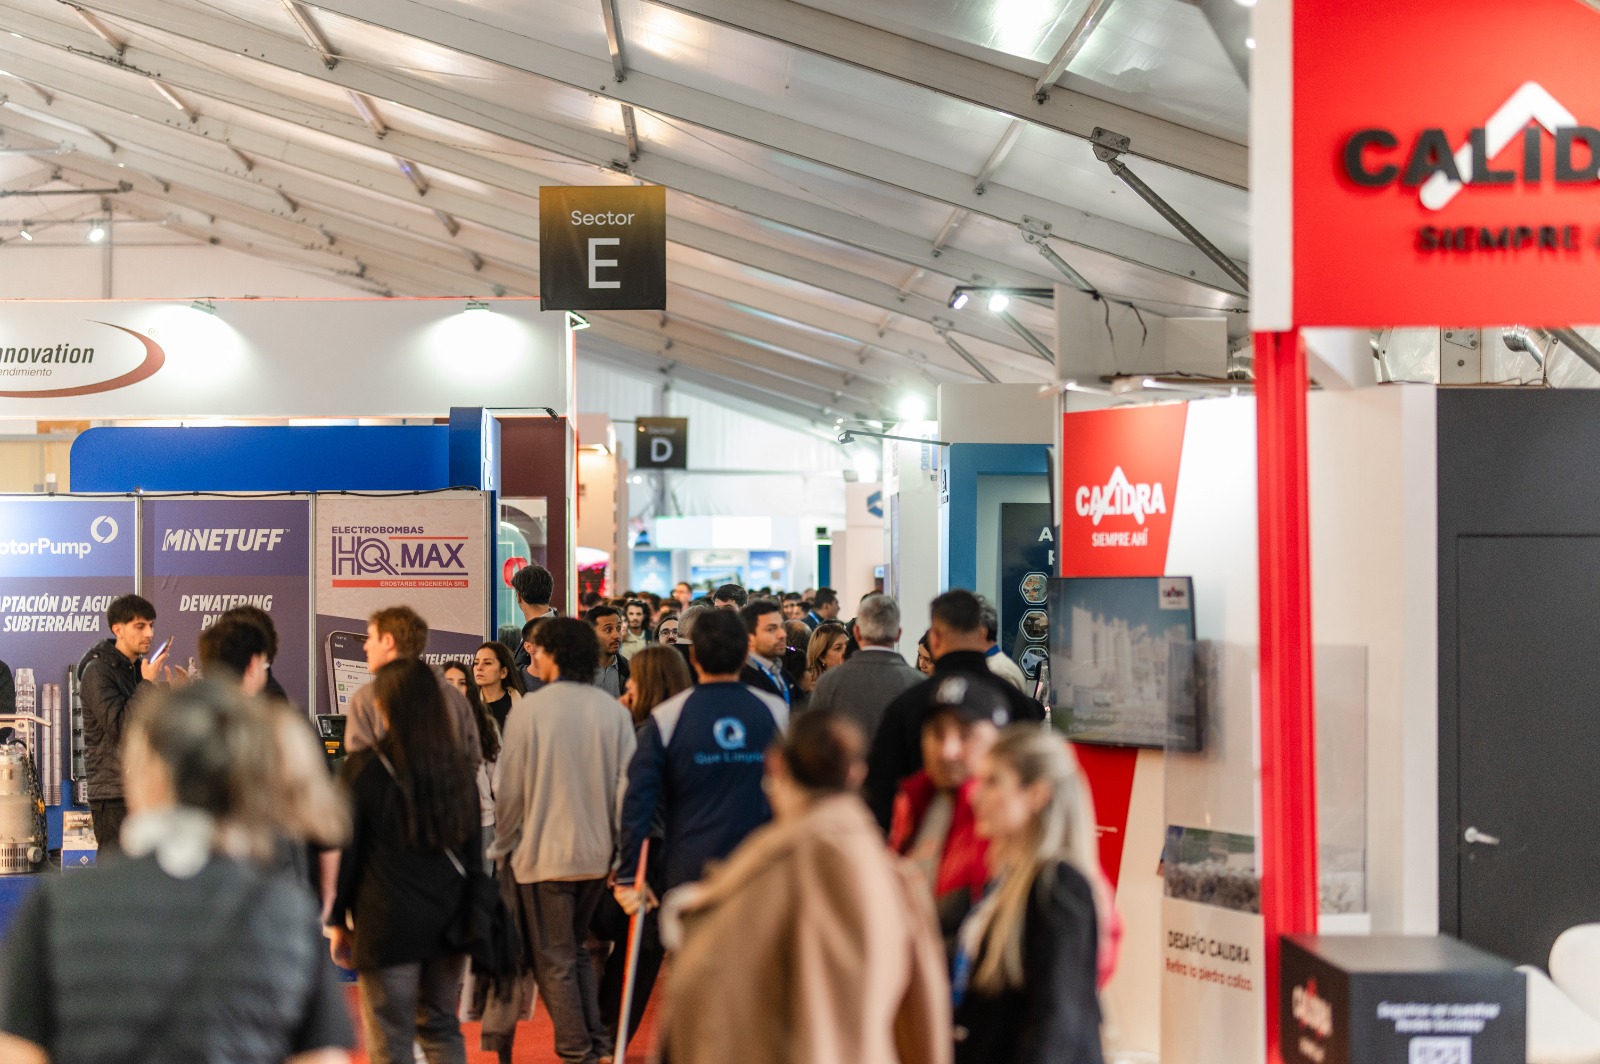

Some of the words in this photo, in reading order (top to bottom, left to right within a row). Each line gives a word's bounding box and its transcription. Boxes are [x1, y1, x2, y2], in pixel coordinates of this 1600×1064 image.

[571, 210, 635, 226] Sector
[1420, 224, 1582, 252] SIEMPRE
[588, 237, 621, 289] E
[651, 437, 673, 463] D
[1075, 482, 1167, 517] CALIDRA
[331, 526, 424, 534] ELECTROBOMBAS
[1092, 532, 1131, 547] SIEMPRE
[1131, 527, 1149, 546] AHÍ
[418, 579, 453, 587] INGENIERÍA
[0, 593, 60, 613] PTACIÓN
[61, 595, 81, 612] DE
[179, 595, 273, 612] DEWATERING
[3, 613, 100, 632] SUBTERRÁNEA
